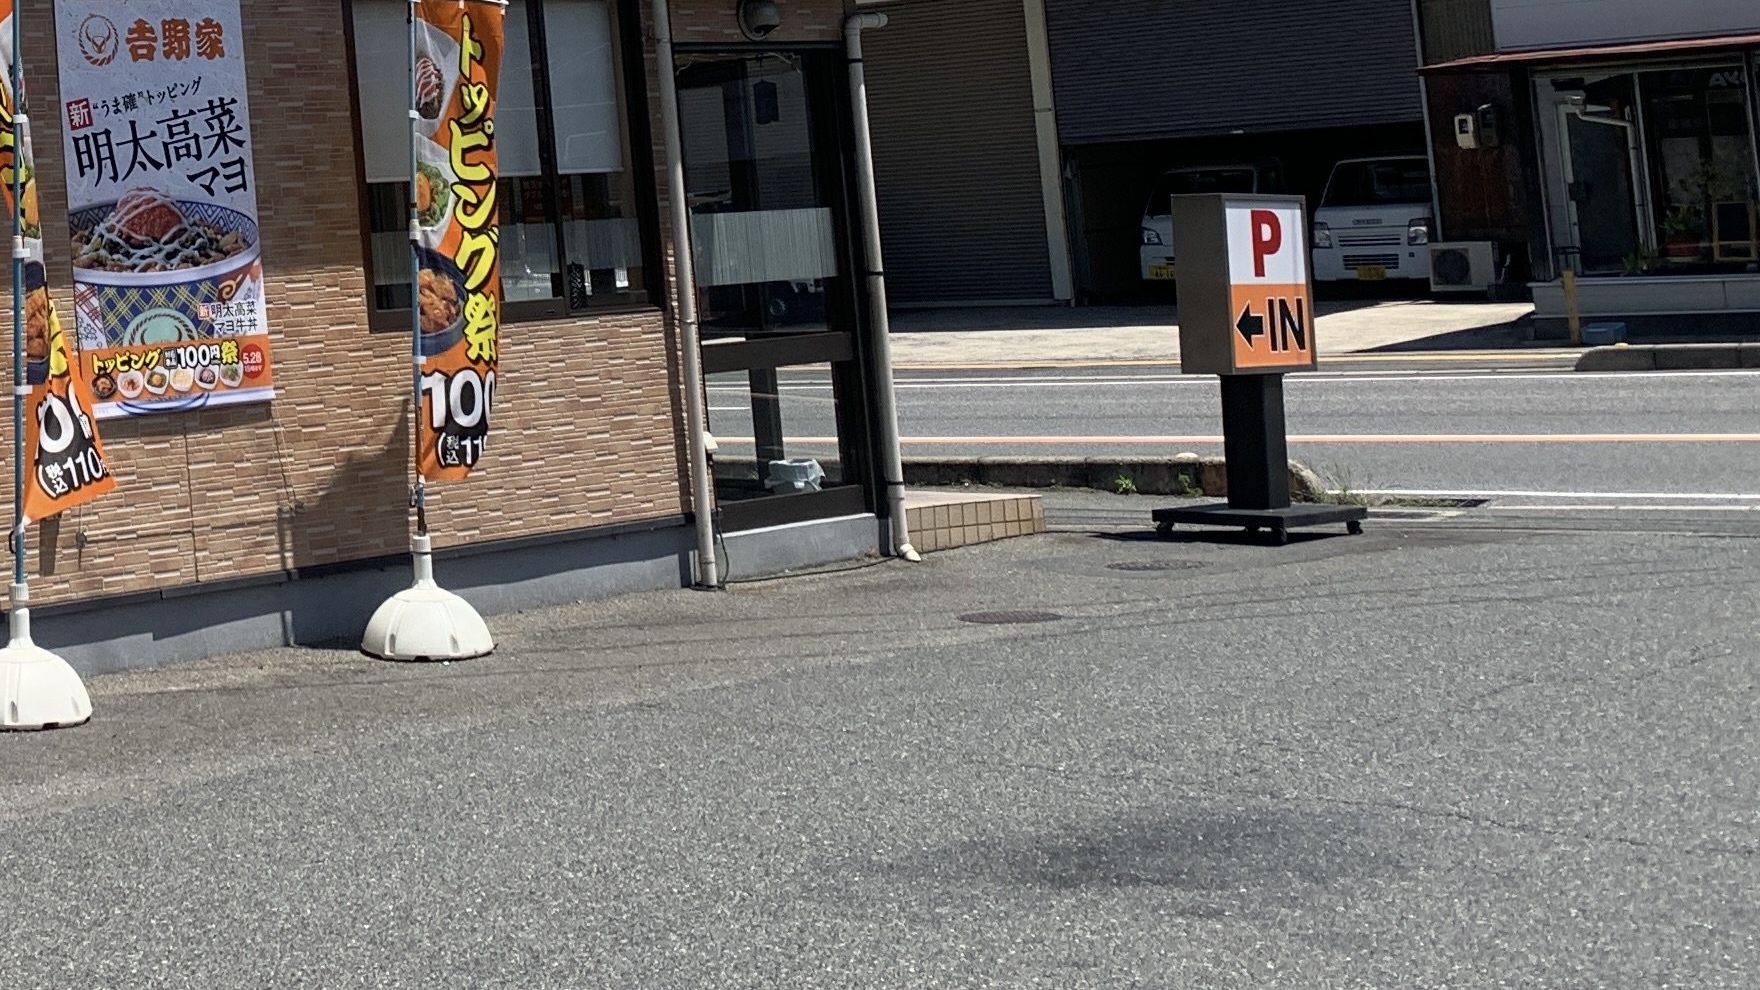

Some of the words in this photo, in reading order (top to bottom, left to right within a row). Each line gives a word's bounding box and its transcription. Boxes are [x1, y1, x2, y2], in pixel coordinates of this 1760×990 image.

[125, 17, 226, 62] 吉野家
[69, 100, 90, 127] 新
[71, 97, 246, 188] 明太高菜
[185, 156, 248, 198] マヨ
[1250, 210, 1282, 277] P
[1267, 296, 1307, 354] IN
[91, 347, 163, 375] トッピング
